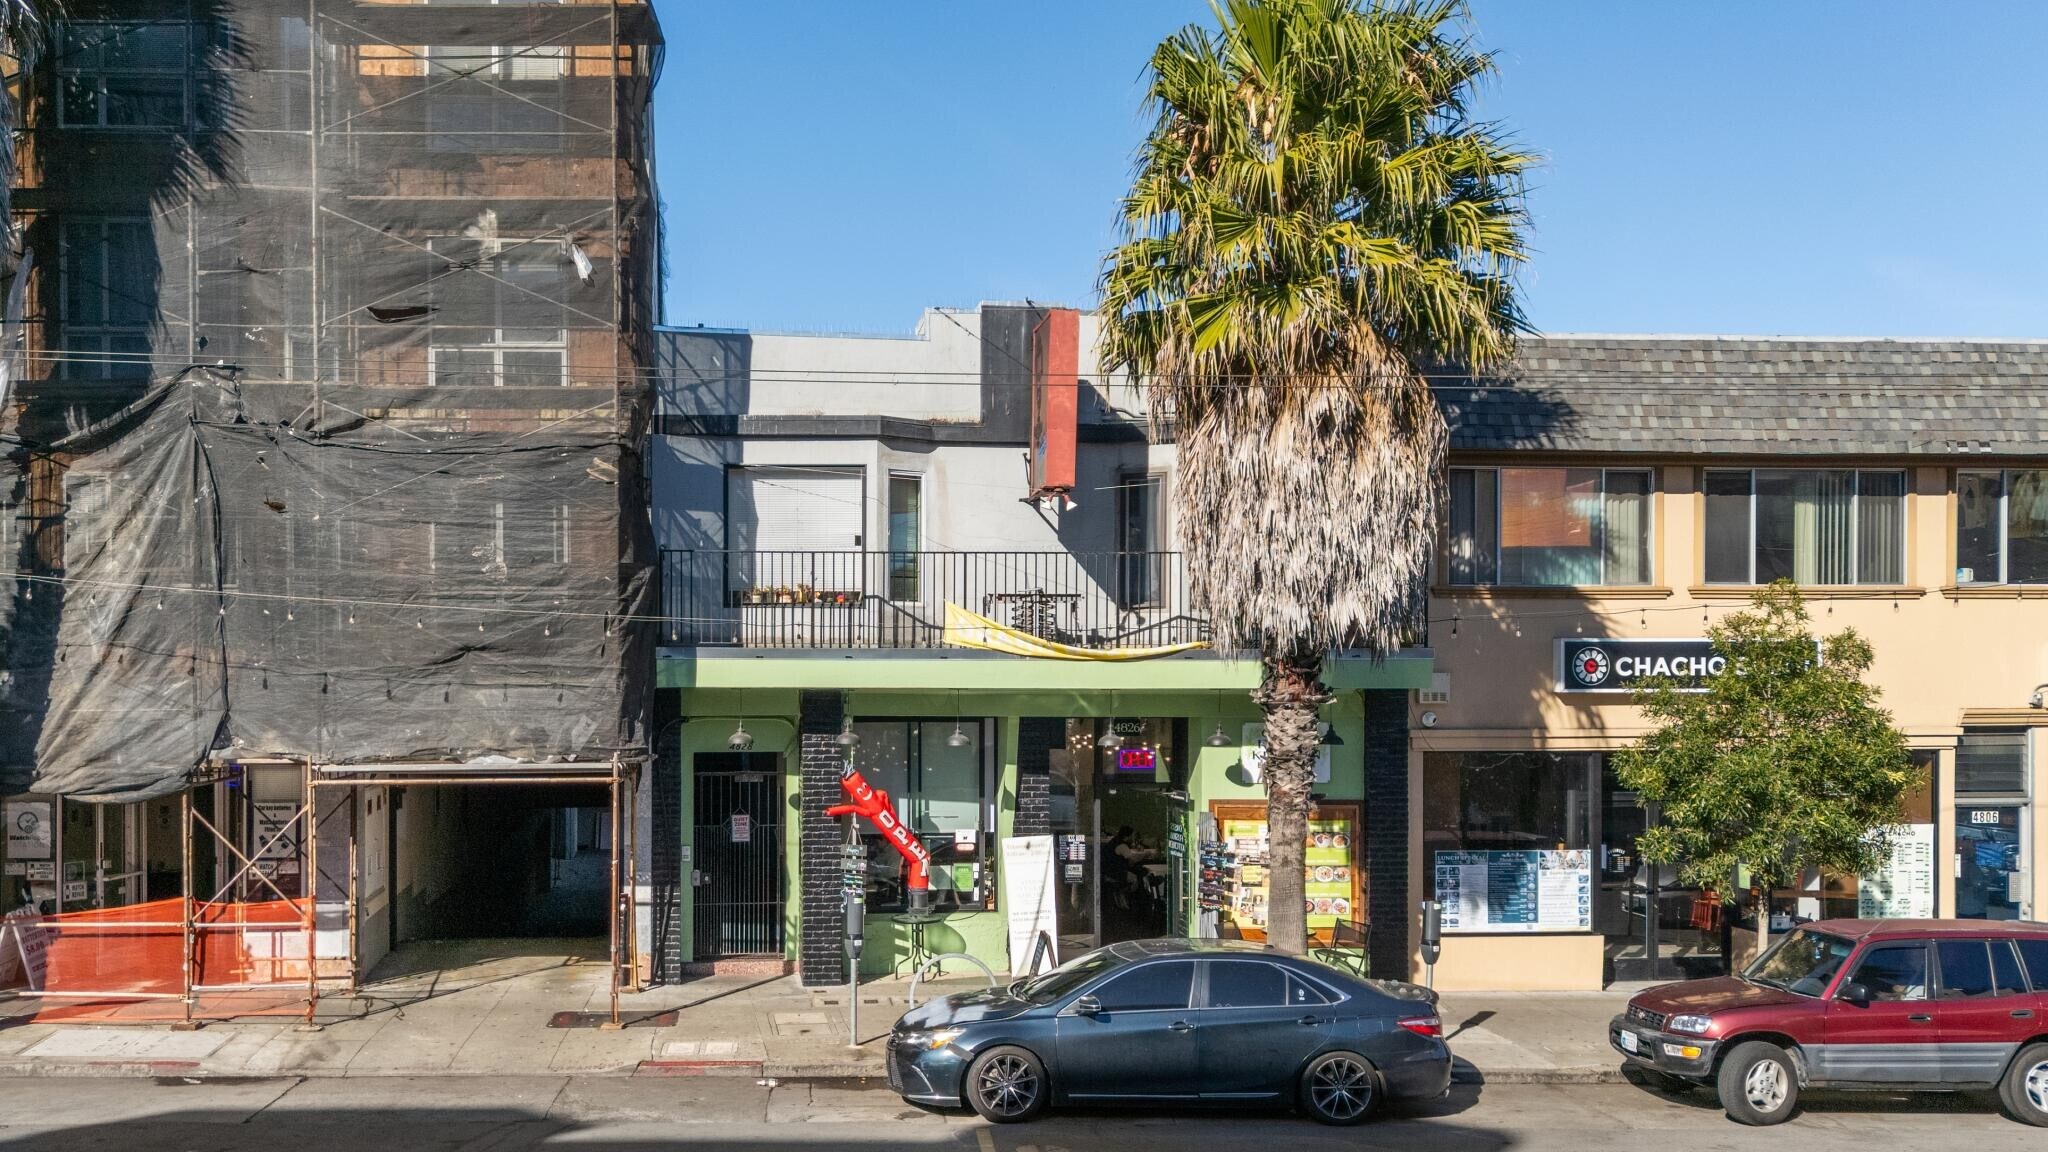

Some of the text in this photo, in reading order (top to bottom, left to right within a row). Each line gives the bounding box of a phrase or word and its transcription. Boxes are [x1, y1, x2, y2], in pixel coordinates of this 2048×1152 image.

[1121, 751, 1153, 767] OPEN
[1973, 812, 1998, 823] 4806
[879, 809, 930, 877] OPEN
